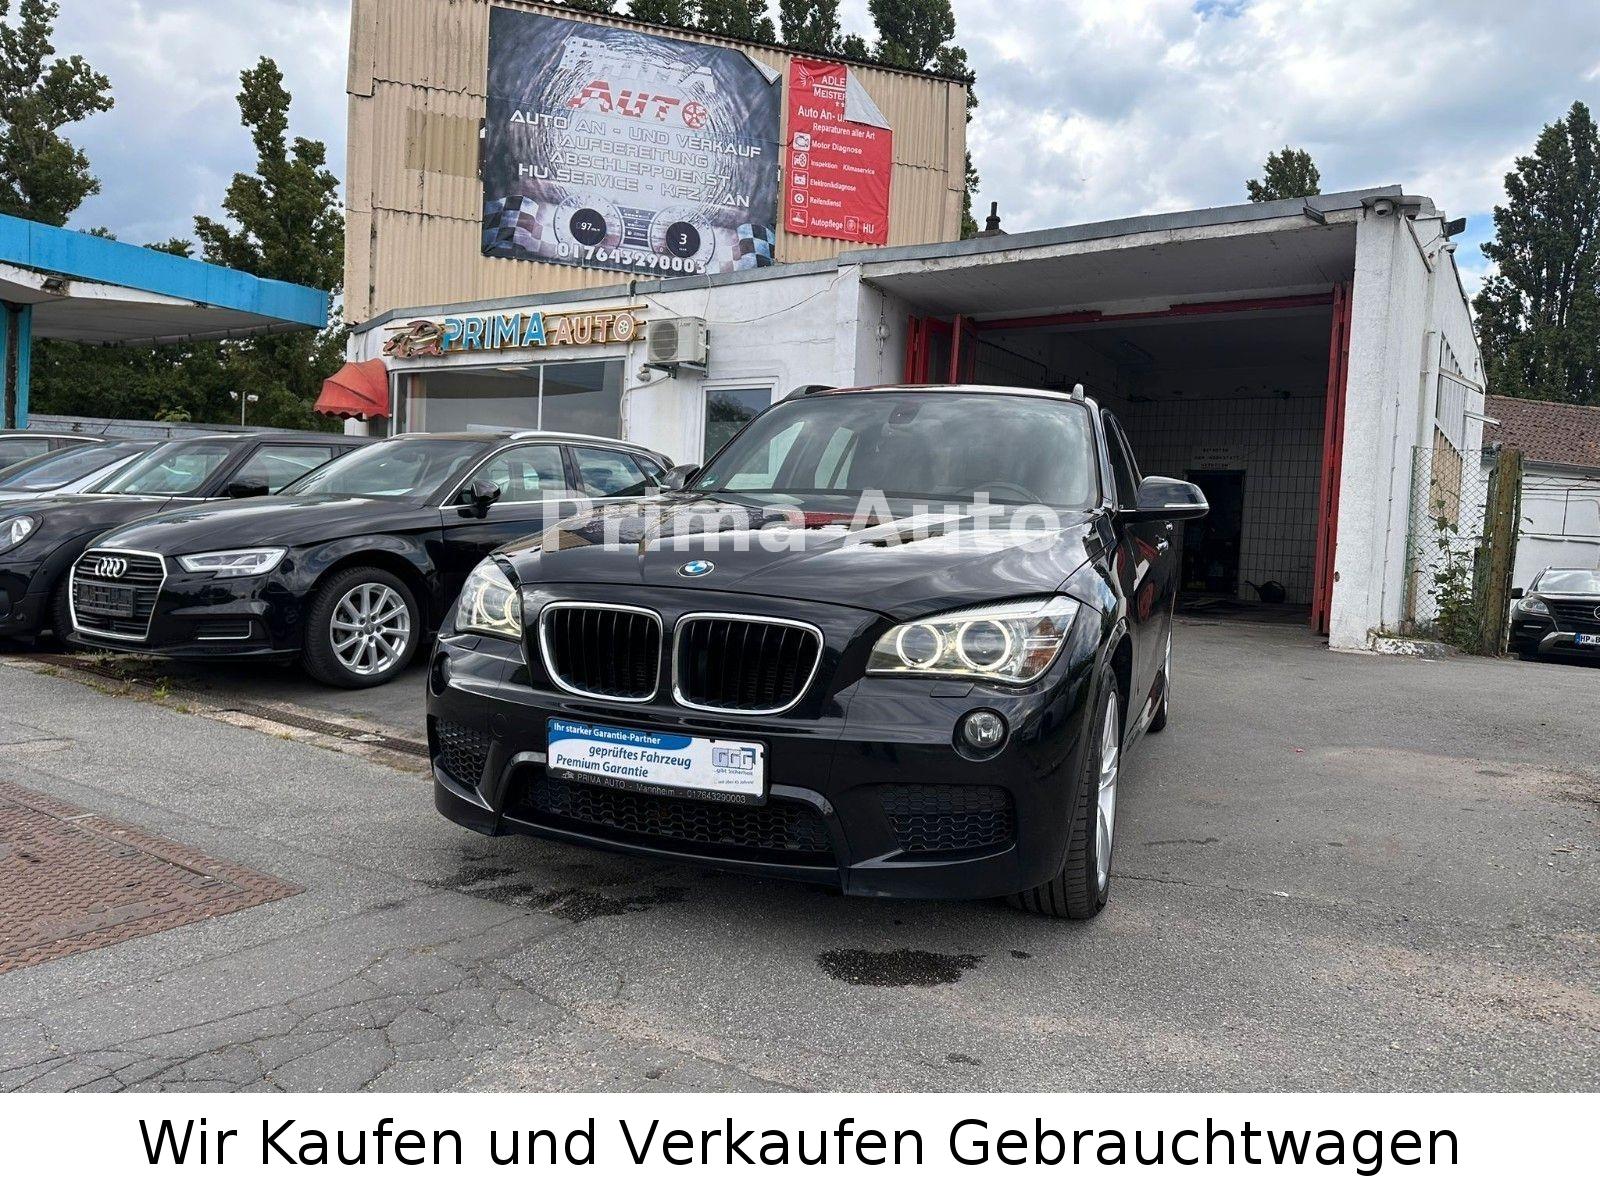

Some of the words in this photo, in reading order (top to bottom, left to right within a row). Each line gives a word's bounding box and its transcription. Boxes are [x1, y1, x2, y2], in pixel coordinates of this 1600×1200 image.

[821, 75, 846, 88] ADLE
[798, 105, 819, 118] Auto
[820, 108, 836, 121] An-
[510, 109, 568, 130] AUTO
[575, 119, 606, 136] AN
[629, 126, 669, 145] UND
[677, 133, 762, 158] VERKAUF
[812, 122, 851, 136] Reparaturen
[851, 128, 865, 138] aller
[865, 132, 876, 140] Art
[560, 135, 709, 168] AUFBEREITUNG
[811, 139, 831, 149] Motor
[831, 142, 863, 155] Diagnose
[550, 151, 731, 188] ABSCHLEPPDIENST
[810, 159, 838, 169] Inspektion
[842, 163, 876, 175] Klimaservice
[518, 163, 549, 179] HU
[556, 169, 639, 193] SERVICE
[660, 182, 701, 201] KFZ
[810, 217, 844, 231] Autopflege
[862, 222, 875, 235] HU
[678, 233, 688, 245] 3
[556, 241, 707, 274] 017643290003
[442, 312, 548, 351] PRIMA
[553, 313, 636, 345] AUTO
[553, 722, 564, 732] Ihr
[565, 724, 592, 736] starker
[593, 728, 661, 745] Garantie-Partner
[556, 753, 601, 771] Premium
[602, 761, 649, 778] Garantie
[589, 745, 638, 762] geprüftes
[640, 750, 692, 770] Fahrzeug
[577, 773, 601, 784] PRIMA
[604, 777, 626, 789] AUTO
[635, 782, 675, 796] Mannheim
